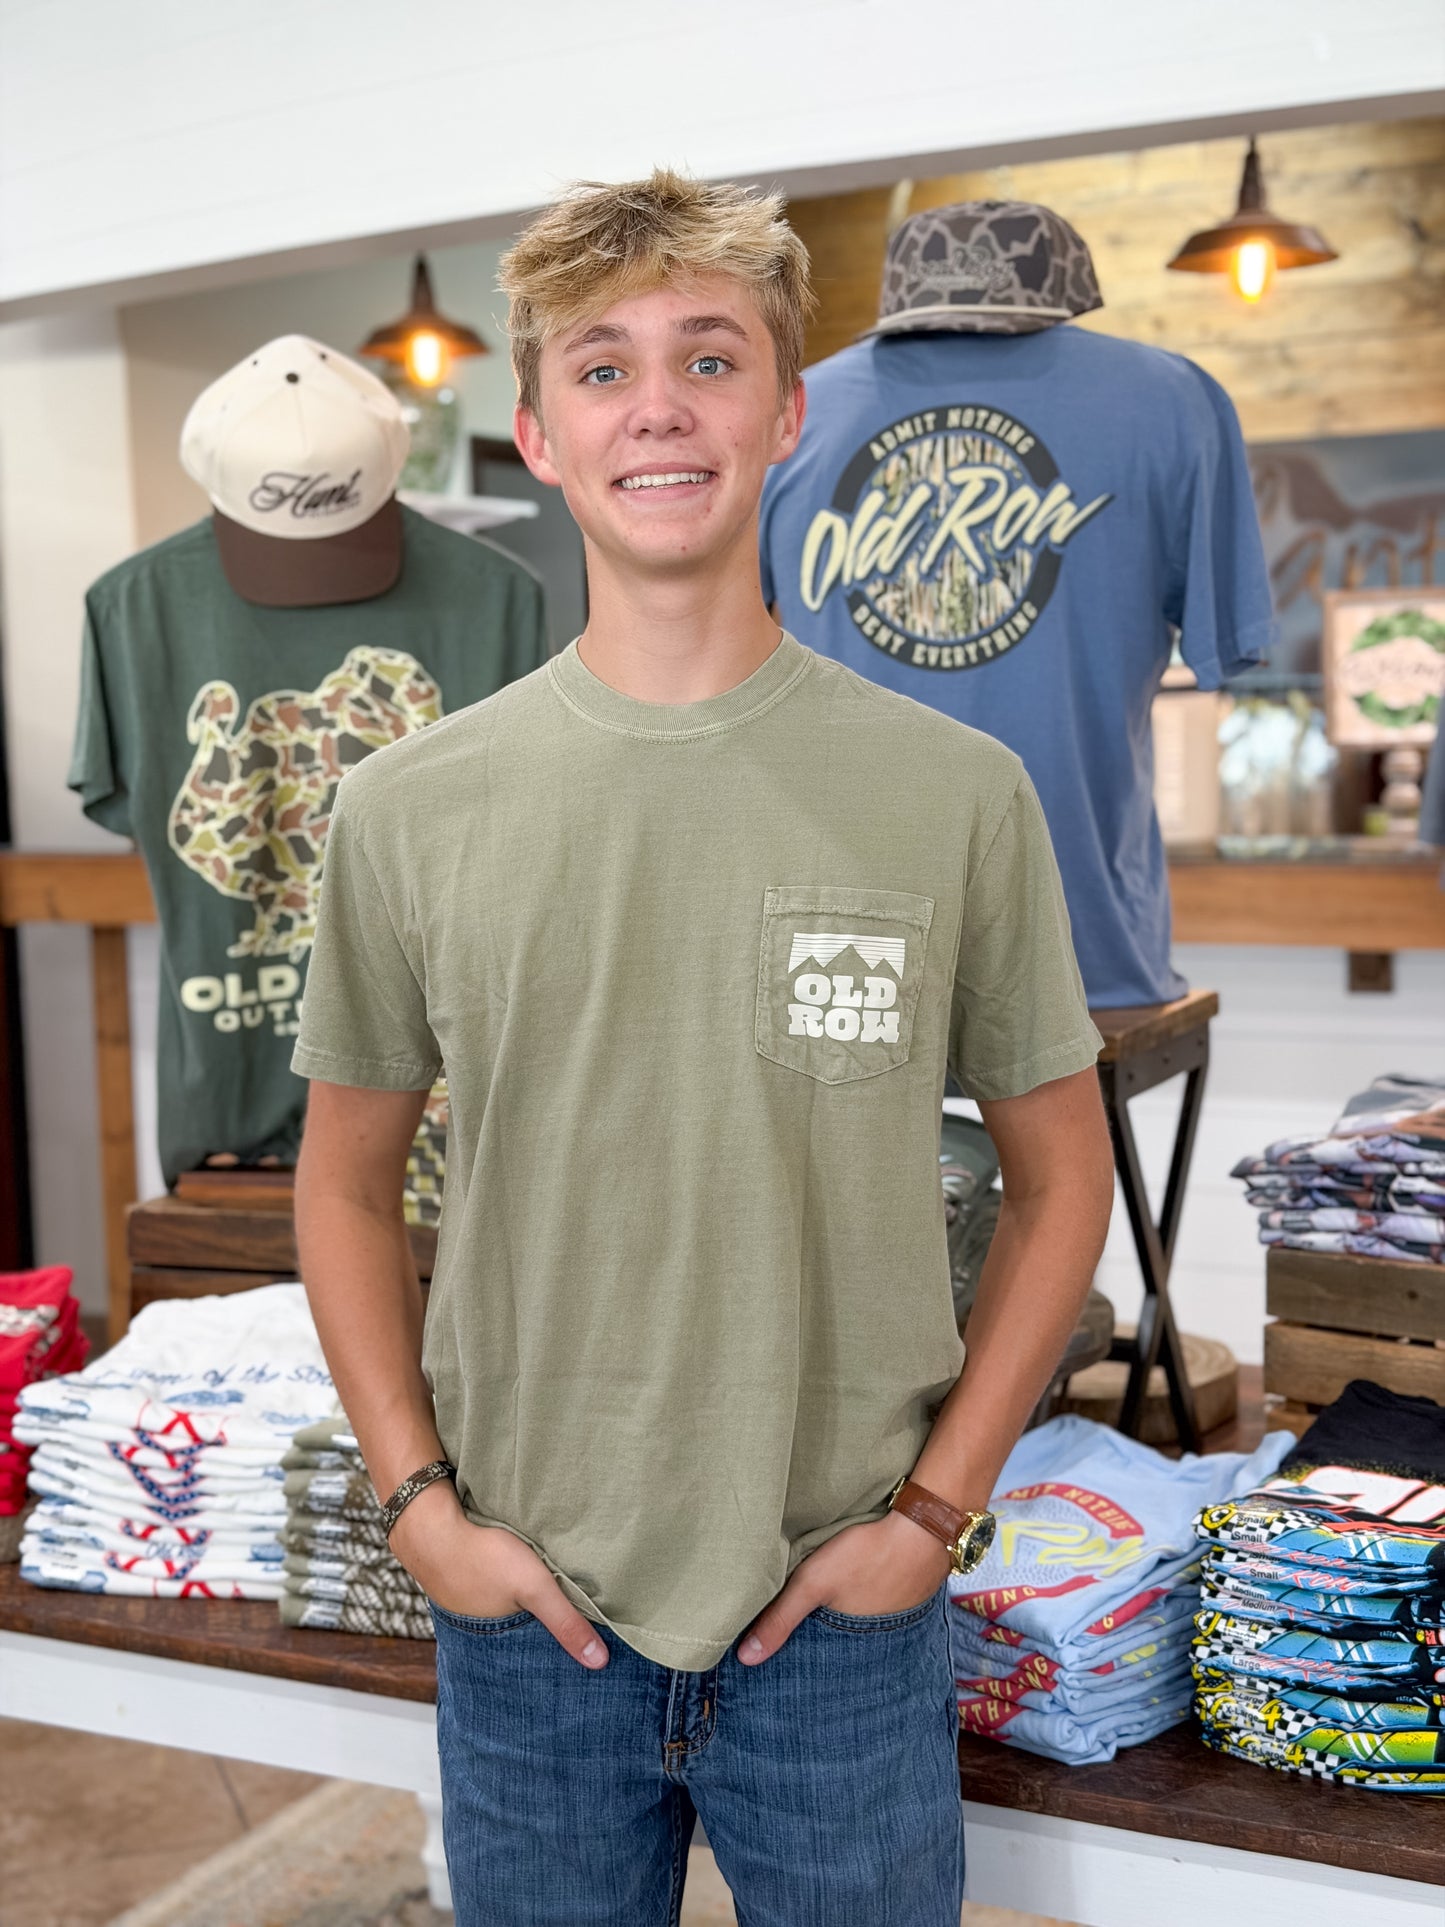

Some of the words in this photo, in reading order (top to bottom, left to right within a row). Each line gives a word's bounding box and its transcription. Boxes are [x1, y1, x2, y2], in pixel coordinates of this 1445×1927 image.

[869, 411, 937, 461] ADMIT
[946, 407, 1036, 455] NOTHING
[800, 483, 933, 611] Old
[920, 465, 1110, 574] Row
[852, 604, 907, 655] DENY
[911, 601, 1039, 668] EVERYTHING
[181, 964, 300, 1013] OLD
[794, 973, 897, 1009] OLD
[213, 999, 303, 1033] OUT
[787, 1003, 900, 1044] ROW
[1008, 1483, 1058, 1500] MIT
[1237, 1512, 1267, 1525] Small
[1233, 1530, 1263, 1543] Small
[1249, 1568, 1279, 1580] Small
[1231, 1584, 1266, 1600] Medium
[1241, 1599, 1277, 1612] Medium
[1231, 1655, 1261, 1671] Large
[1229, 1691, 1264, 1704] X-Large
[1226, 1705, 1259, 1721] X-Large
[1251, 1744, 1286, 1760] X-Large
